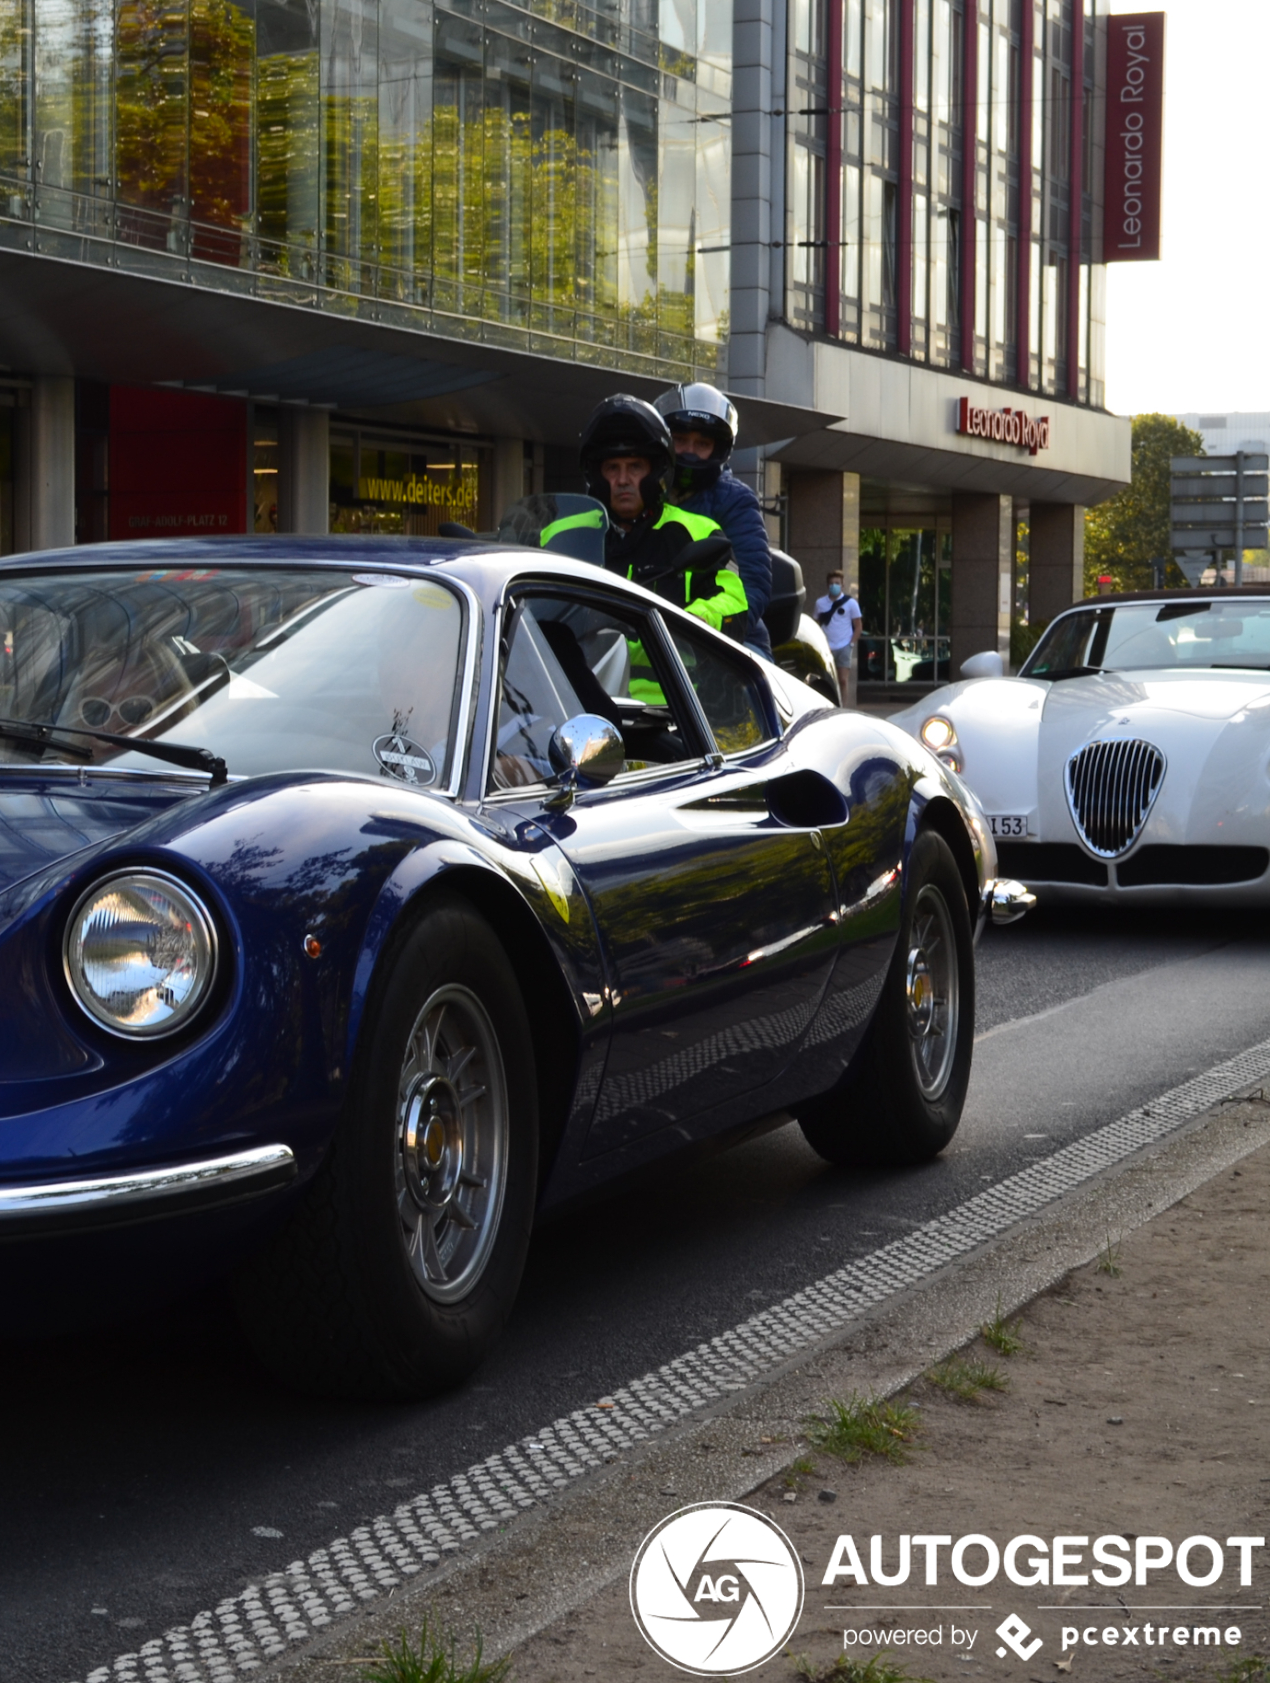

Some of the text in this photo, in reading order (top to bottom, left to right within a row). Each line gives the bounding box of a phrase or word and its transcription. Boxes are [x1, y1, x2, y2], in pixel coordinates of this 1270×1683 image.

[1117, 24, 1147, 249] Leonardo Royal
[687, 410, 711, 420] NEXO
[963, 397, 1049, 451] Leonardo Royal
[367, 472, 474, 508] www.deiters.de
[128, 514, 228, 528] GRAF-ADOLF-PLATZ 12
[1001, 817, 1023, 835] 53
